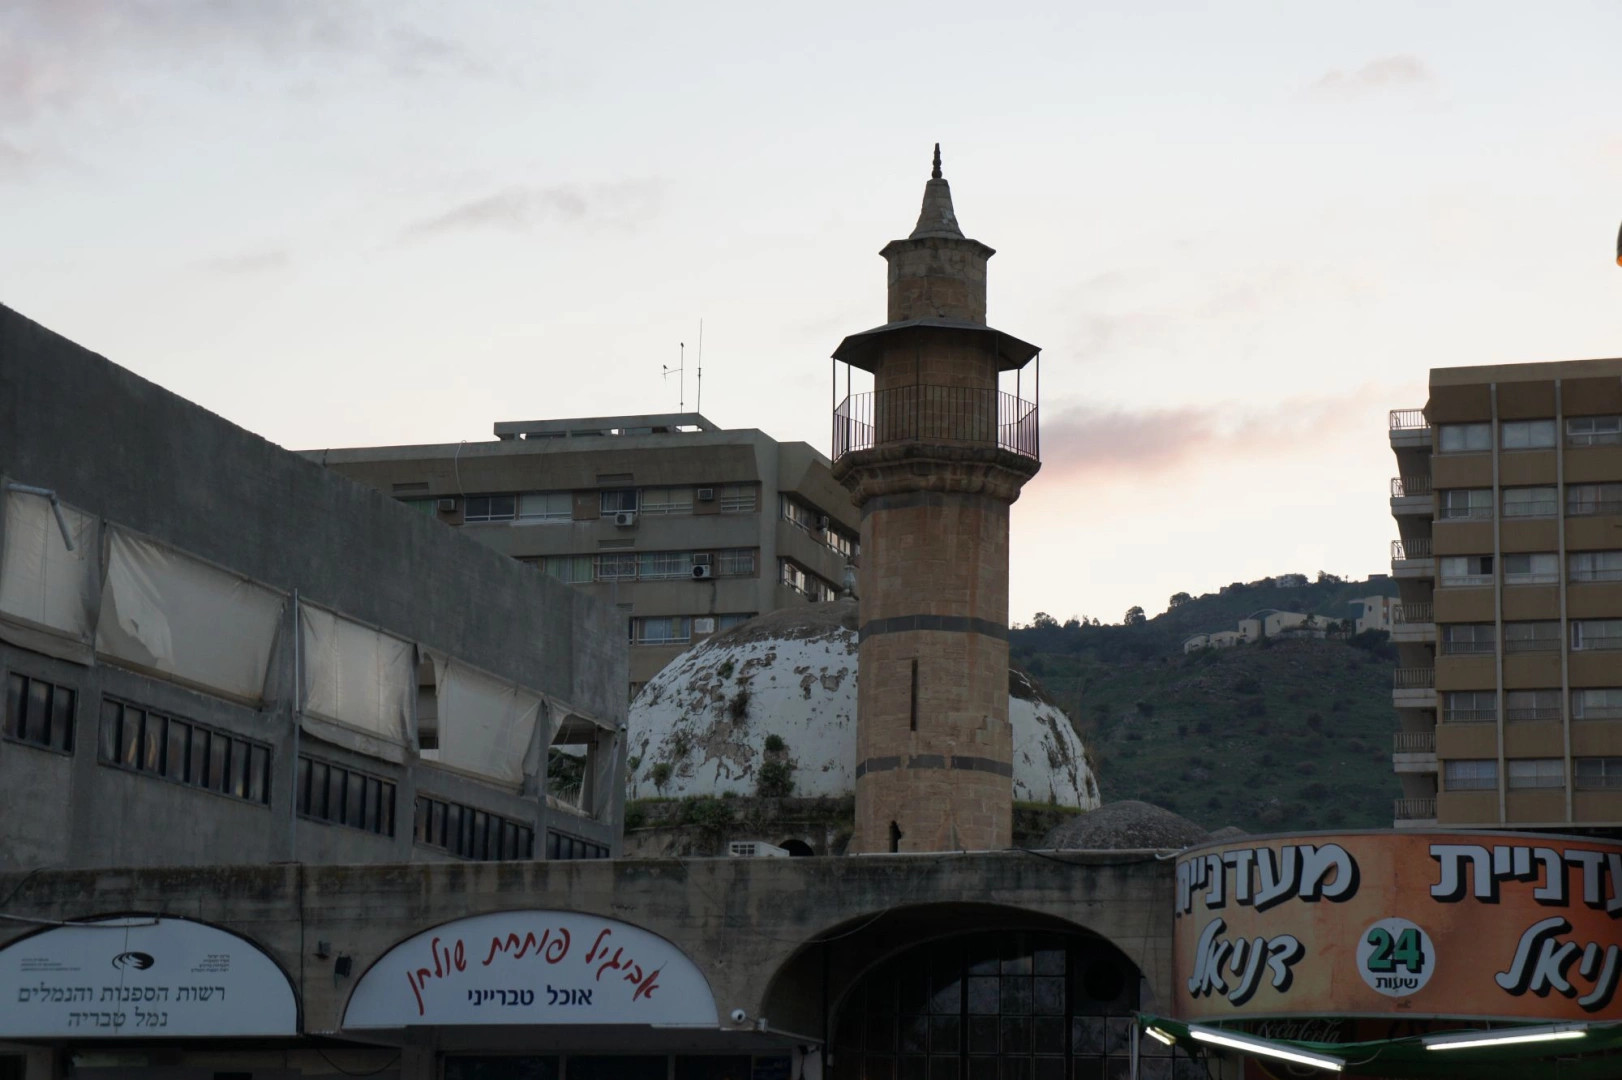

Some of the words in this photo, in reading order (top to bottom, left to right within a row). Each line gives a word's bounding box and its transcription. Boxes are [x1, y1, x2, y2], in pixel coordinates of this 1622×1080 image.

[1174, 843, 1359, 919] מעדניית
[1429, 844, 1622, 920] דניית
[482, 928, 571, 966] פותחת
[1367, 927, 1425, 974] 24
[585, 929, 660, 1001] אביגיל
[1188, 917, 1305, 1007] דניאל
[1494, 916, 1622, 1012] ניאל
[407, 937, 467, 1017] שולחן
[1375, 976, 1418, 990] שעות
[18, 982, 93, 1002] והנמלים
[100, 986, 168, 1002] הספנות
[176, 985, 226, 1002] רשות
[468, 987, 534, 1006] טברייני
[546, 985, 593, 1006] אוכל
[68, 1012, 126, 1027] טבריה
[134, 1006, 168, 1027] נמל
